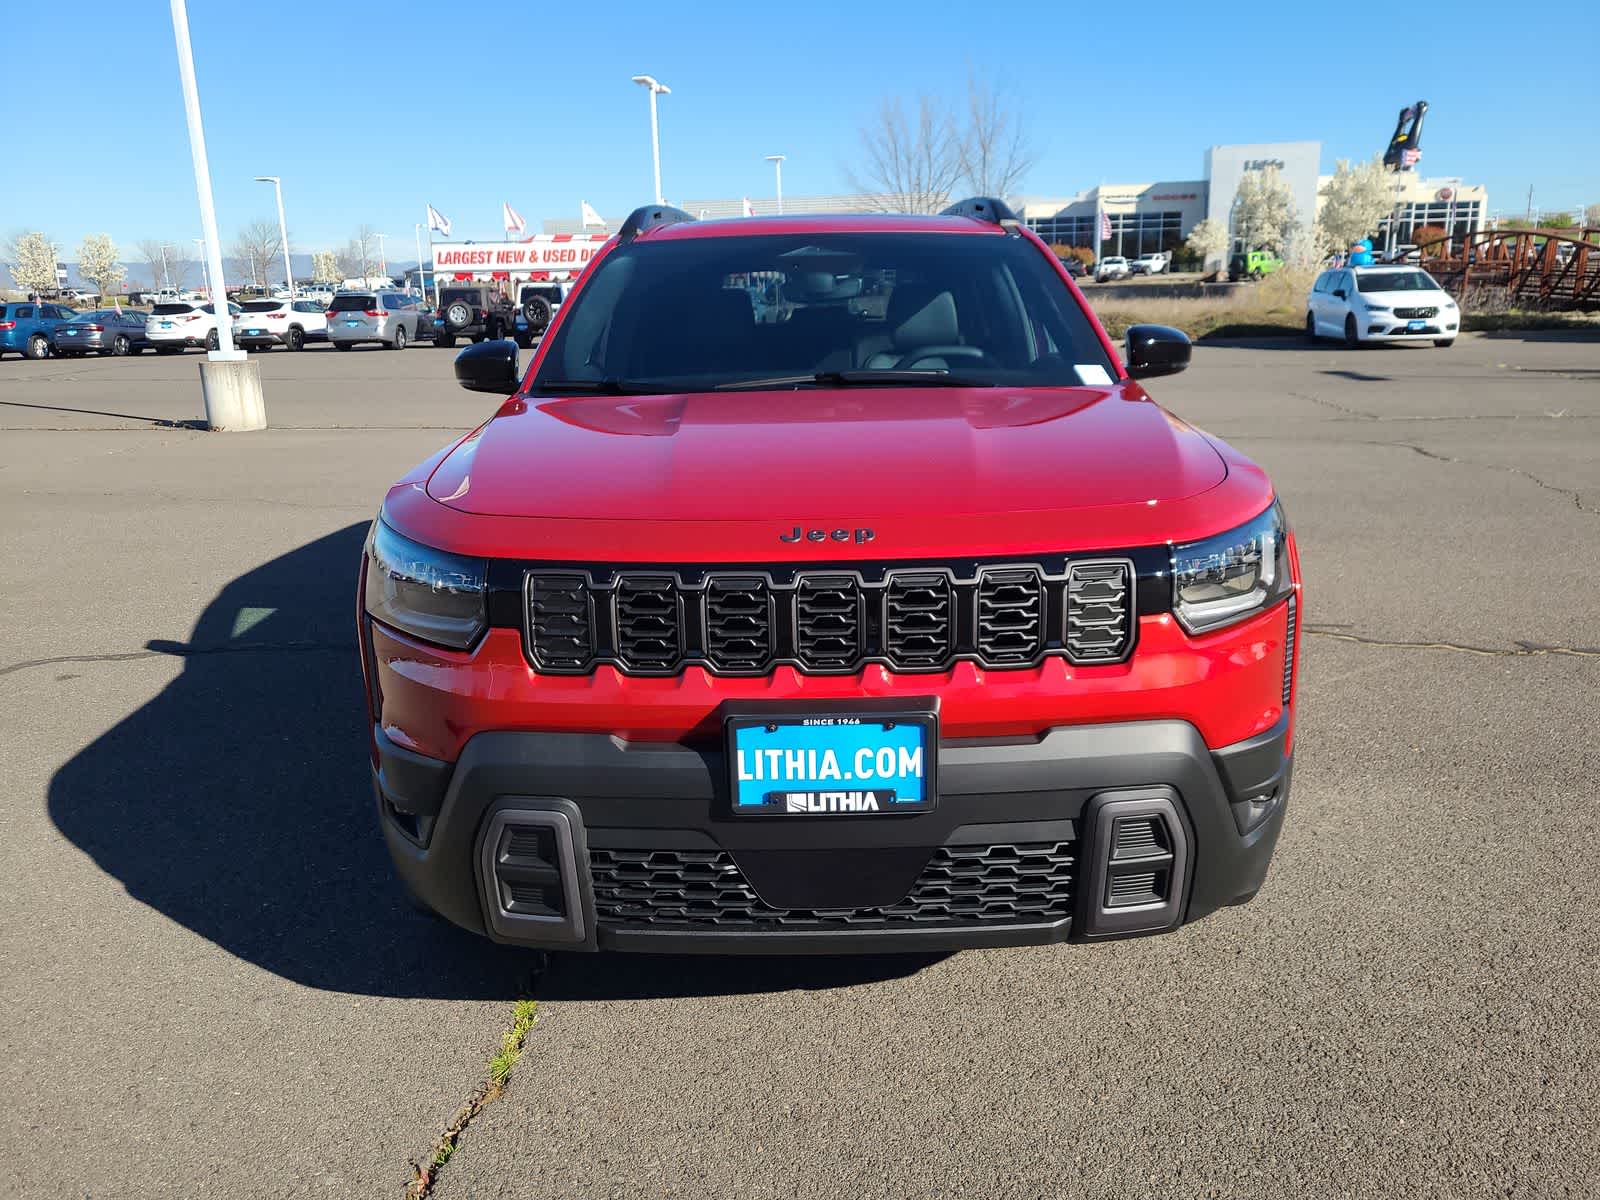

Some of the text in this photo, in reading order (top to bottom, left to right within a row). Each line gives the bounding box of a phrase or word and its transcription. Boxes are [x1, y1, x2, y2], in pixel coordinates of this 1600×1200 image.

[437, 250, 494, 265] LARGEST
[496, 249, 526, 265] NEW
[529, 249, 538, 263] &
[542, 248, 576, 263] USED
[779, 527, 876, 544] Jeep
[802, 717, 861, 726] SINCE 1946
[736, 746, 924, 781] LITHIA.COM
[808, 791, 879, 812] LITHIA
